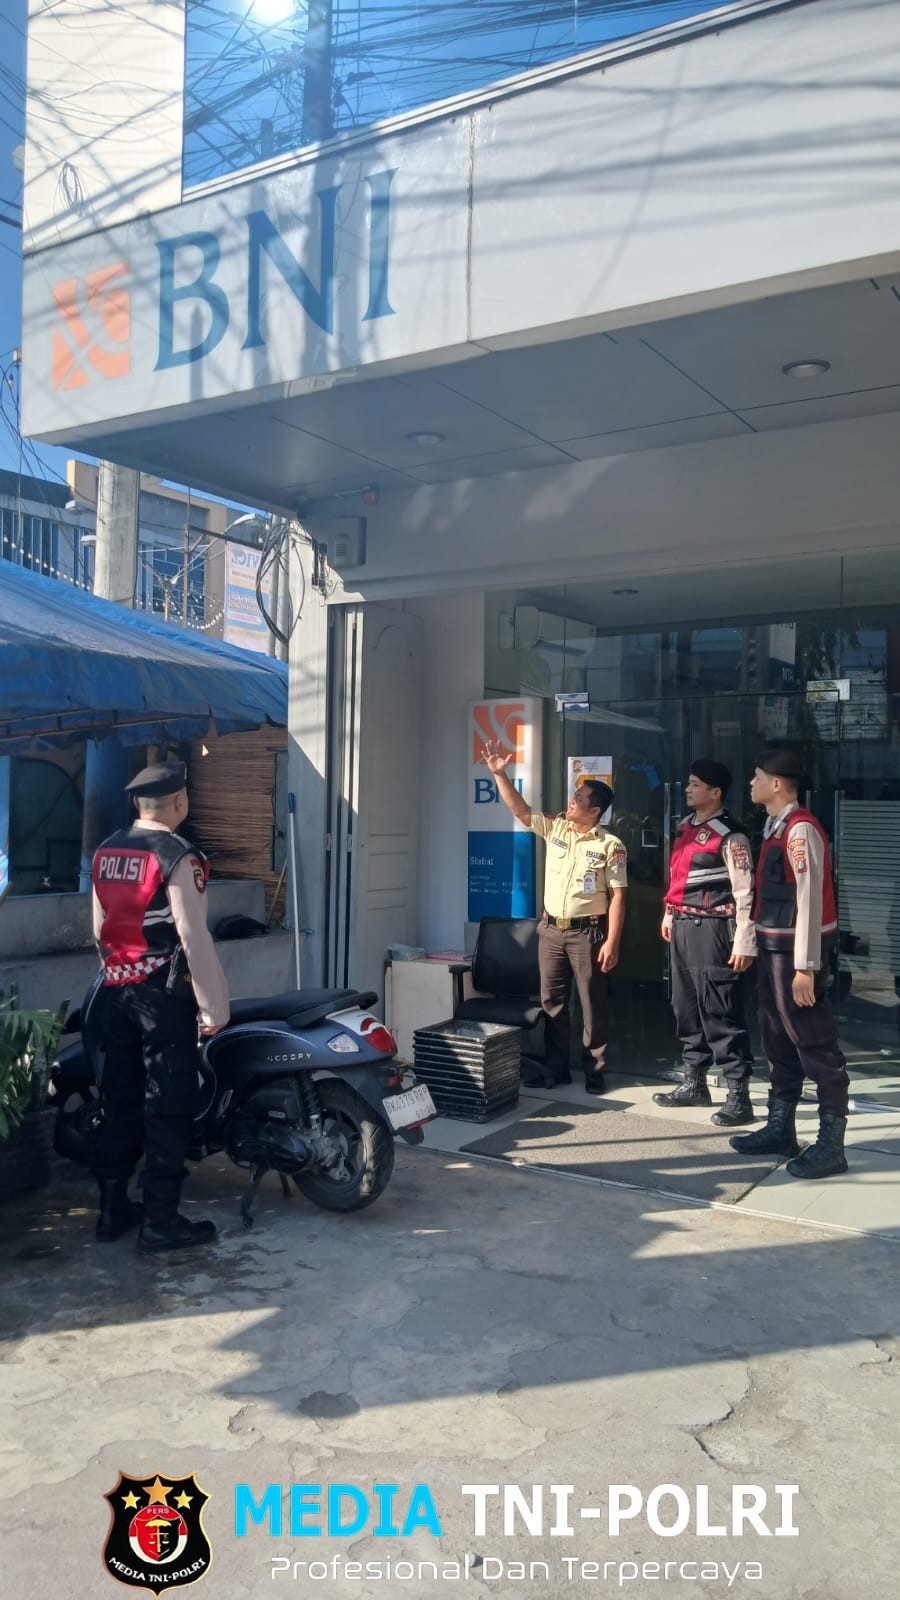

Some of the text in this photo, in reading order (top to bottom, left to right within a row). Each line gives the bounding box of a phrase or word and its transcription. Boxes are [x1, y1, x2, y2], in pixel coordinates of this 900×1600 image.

[153, 169, 398, 372] BNI
[98, 856, 145, 881] POLISI
[469, 856, 494, 865] Stabat
